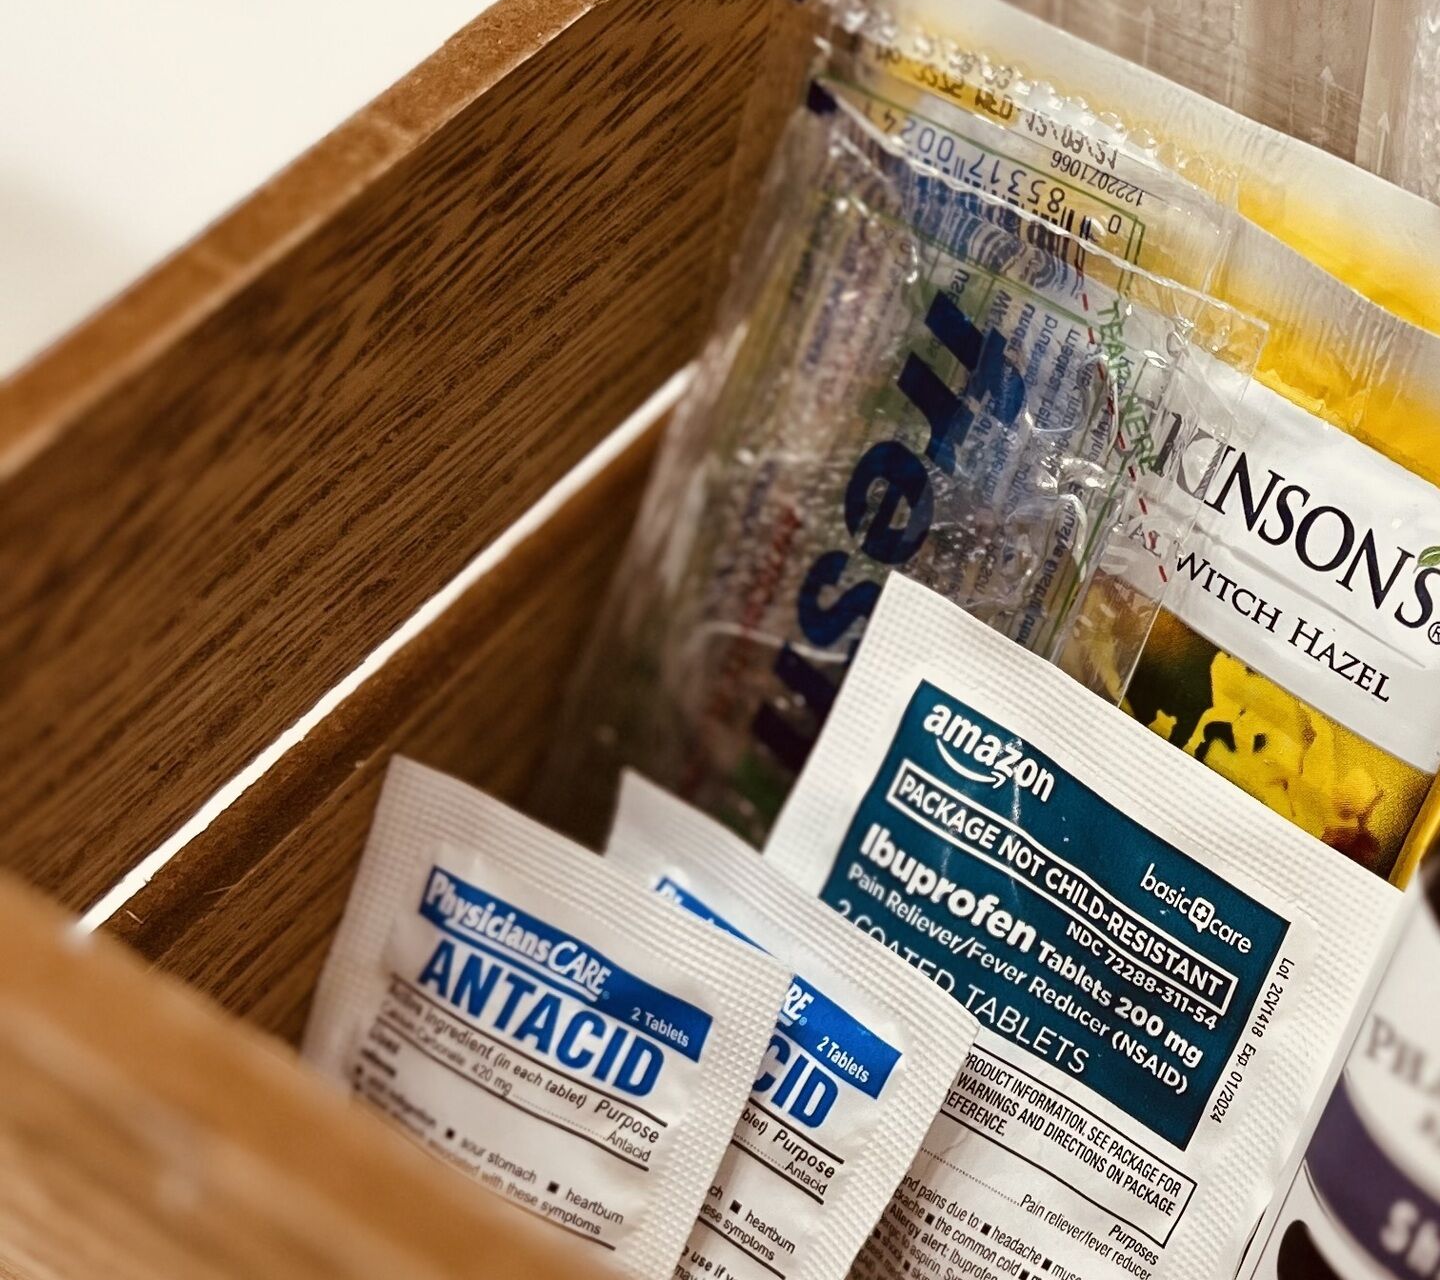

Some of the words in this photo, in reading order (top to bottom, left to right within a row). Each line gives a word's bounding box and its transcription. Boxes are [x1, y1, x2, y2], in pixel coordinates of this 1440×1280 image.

[966, 151, 1068, 213] 85317
[1047, 150, 1148, 205] 1222071066
[1176, 558, 1284, 632] WITCH
[1289, 619, 1391, 703] HAZEL
[922, 703, 1055, 802] amazon
[899, 773, 996, 850] PACKAGE
[999, 839, 1045, 878] NOT
[1045, 868, 1221, 999] CHILD-RESISTANT
[1138, 865, 1197, 915] basic
[1207, 917, 1254, 955] care
[859, 824, 1037, 953] Ibuprofen
[1039, 939, 1112, 1005] Tablets
[1114, 995, 1163, 1036] 200
[1161, 1031, 1205, 1068] mg
[1276, 959, 1294, 979] Lot
[845, 863, 890, 900] Pain
[884, 890, 1028, 988] Reliever/Fever
[1028, 972, 1108, 1037] Reducer
[1111, 1029, 1190, 1096] (NSAID)
[1064, 922, 1106, 956] NDC
[1103, 942, 1217, 1029] 72288-311-54
[419, 940, 664, 1097] ANTACID
[629, 1006, 642, 1021] 2
[640, 1013, 691, 1047] Tablets
[962, 984, 1089, 1073] TABLETS
[1248, 984, 1284, 1037] 2CV1418
[815, 1034, 830, 1053] 2
[823, 1043, 875, 1083] Tablets
[1233, 1043, 1256, 1070] Exp.
[512, 1062, 544, 1085] each
[543, 1078, 587, 1109] tablet)
[592, 1100, 662, 1146] Purpose
[1208, 1071, 1243, 1122] 01/2024
[605, 1131, 652, 1163] Antacid
[769, 1129, 840, 1179] Purpose
[957, 1073, 1019, 1118] WARNINGS
[1018, 1109, 1045, 1131] AND
[1041, 1125, 1107, 1172] DIRECTIONS
[1105, 1166, 1124, 1183] ON
[1121, 1177, 1176, 1215] PACKAGE
[1009, 1080, 1090, 1136] INFORMATION.
[1086, 1127, 1110, 1148] SEE
[1106, 1142, 1160, 1182] PACKAGE
[1156, 1174, 1182, 1196] FOR
[486, 1151, 538, 1183] stomach
[565, 1189, 625, 1225] heartburn
[782, 1162, 829, 1195] Antacid
[539, 1198, 602, 1238] symptoms
[719, 1220, 778, 1261] symptoms
[741, 1212, 800, 1253] heartburn
[883, 1205, 925, 1240] Allergy
[916, 1185, 947, 1211] pains
[946, 1201, 968, 1220] due
[990, 1227, 1043, 1265] headache
[933, 1218, 953, 1236] the
[951, 1229, 998, 1263] common
[996, 1255, 1021, 1276] cold
[1019, 1195, 1046, 1218] Pain
[1043, 1210, 1113, 1259] reliever/fever
[1106, 1225, 1161, 1266] Purposes
[689, 1252, 717, 1274] use
